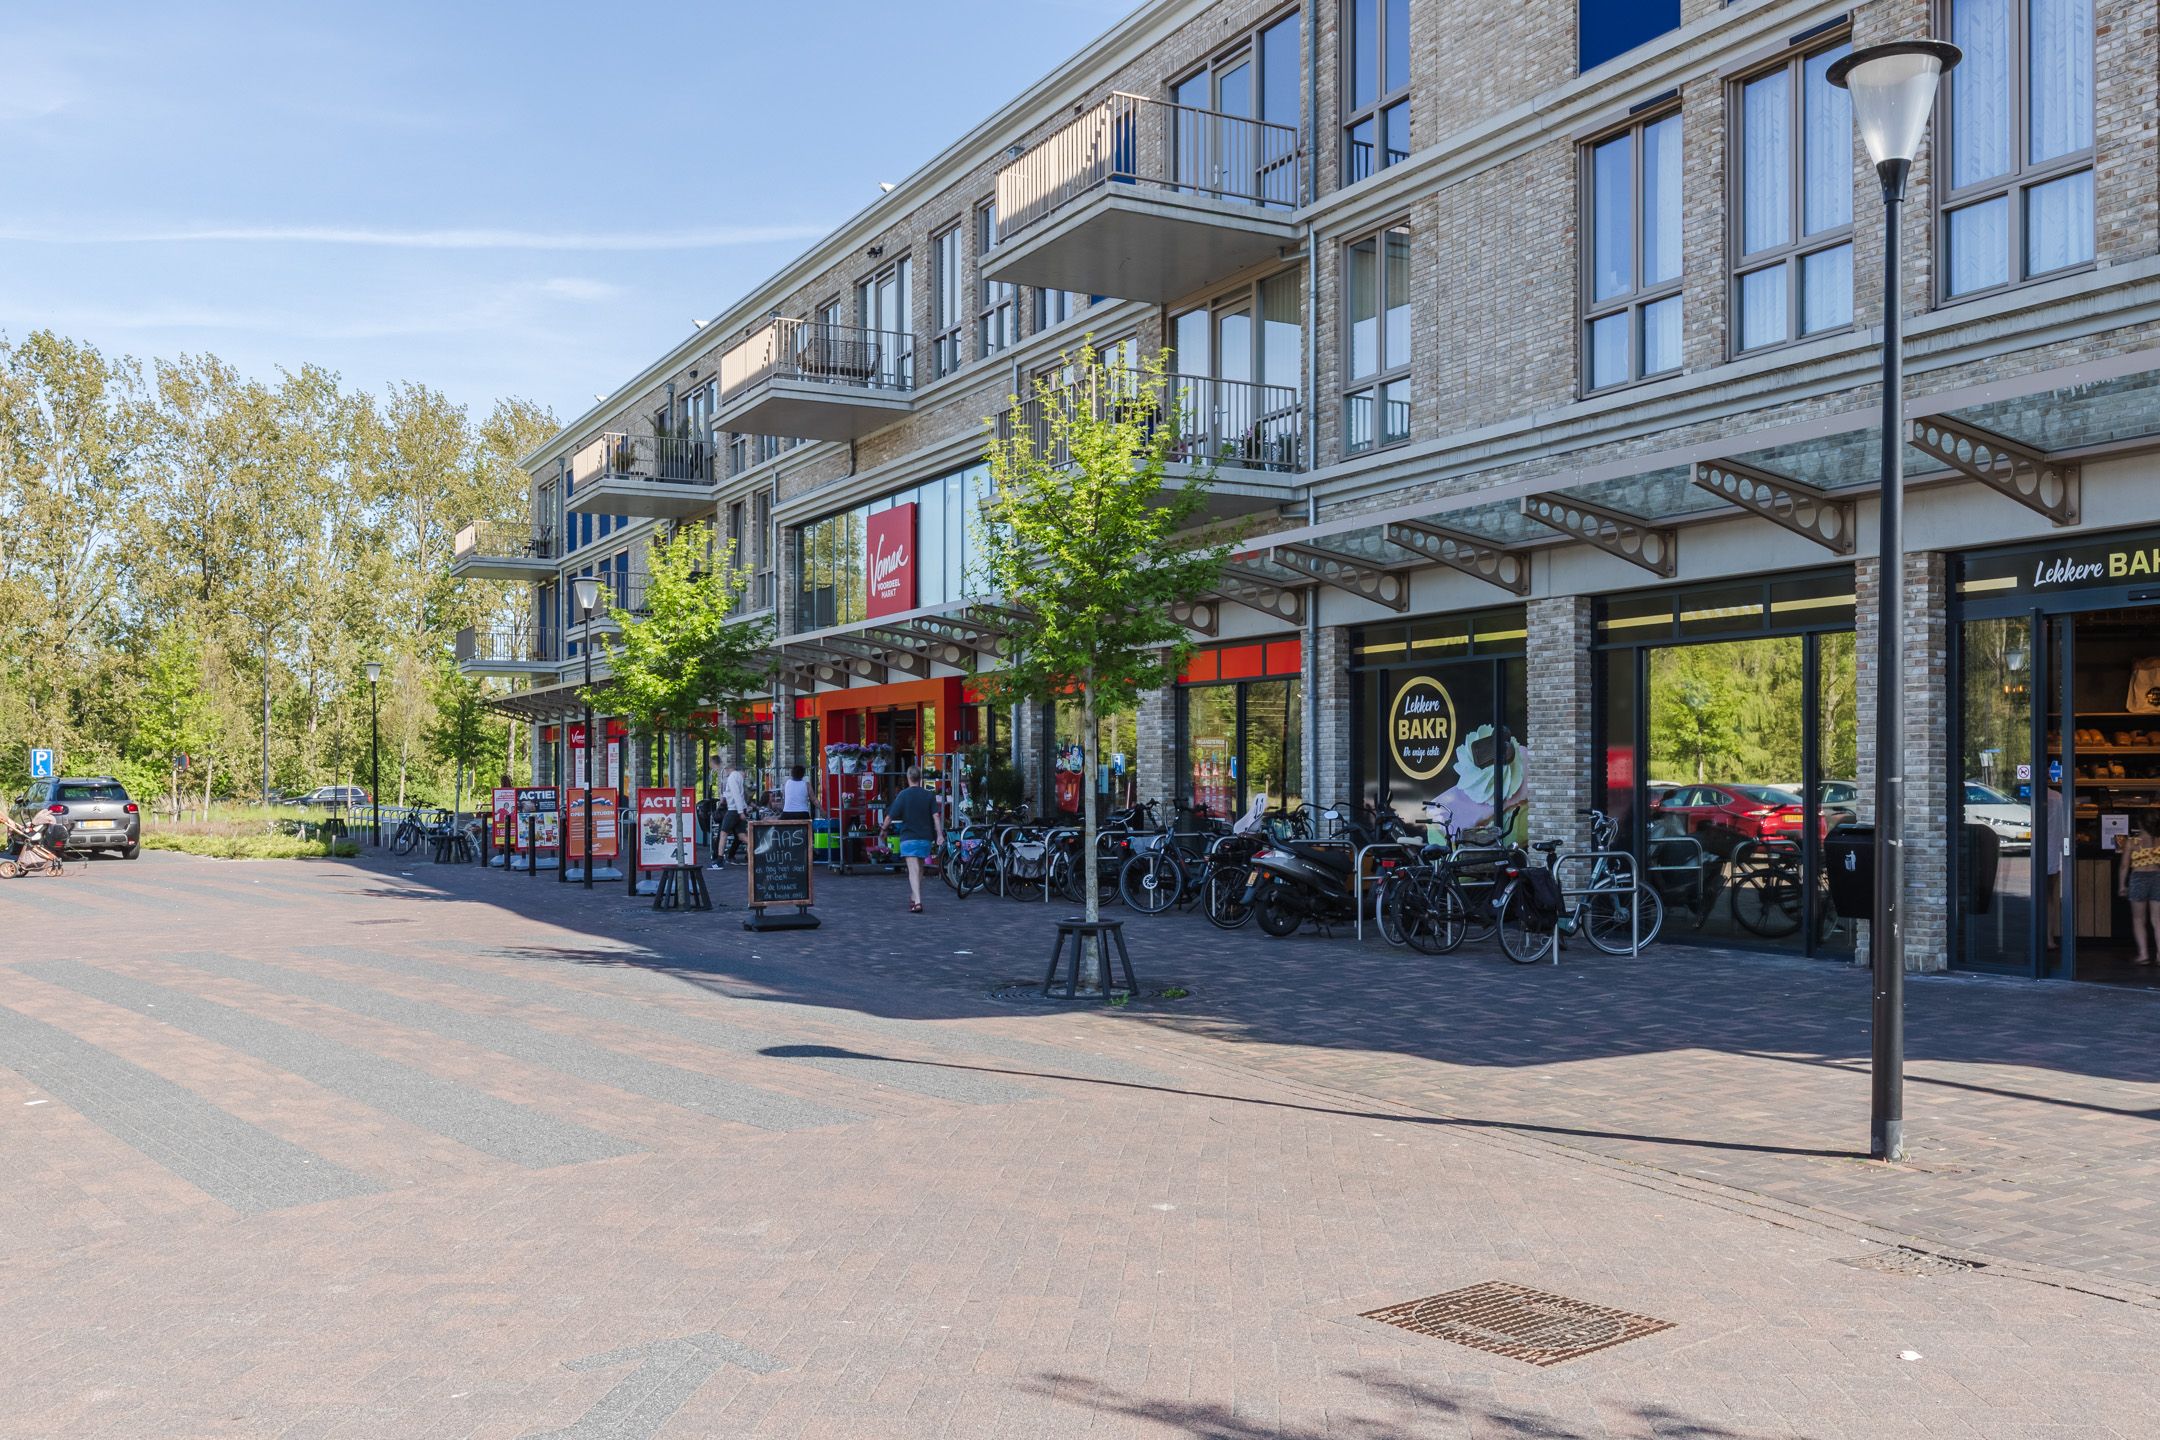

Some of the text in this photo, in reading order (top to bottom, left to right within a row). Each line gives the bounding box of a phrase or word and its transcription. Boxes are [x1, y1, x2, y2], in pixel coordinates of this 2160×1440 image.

[870, 533, 909, 597] Vomar
[2033, 557, 2104, 588] Lekkere
[877, 578, 901, 591] VOORDEEL
[881, 588, 897, 599] MARKT
[1404, 694, 1441, 716] Lekkere
[1398, 717, 1448, 740] BAKR
[36, 752, 48, 765] P
[519, 790, 556, 800] ACTIE!
[766, 850, 792, 864] wijn
